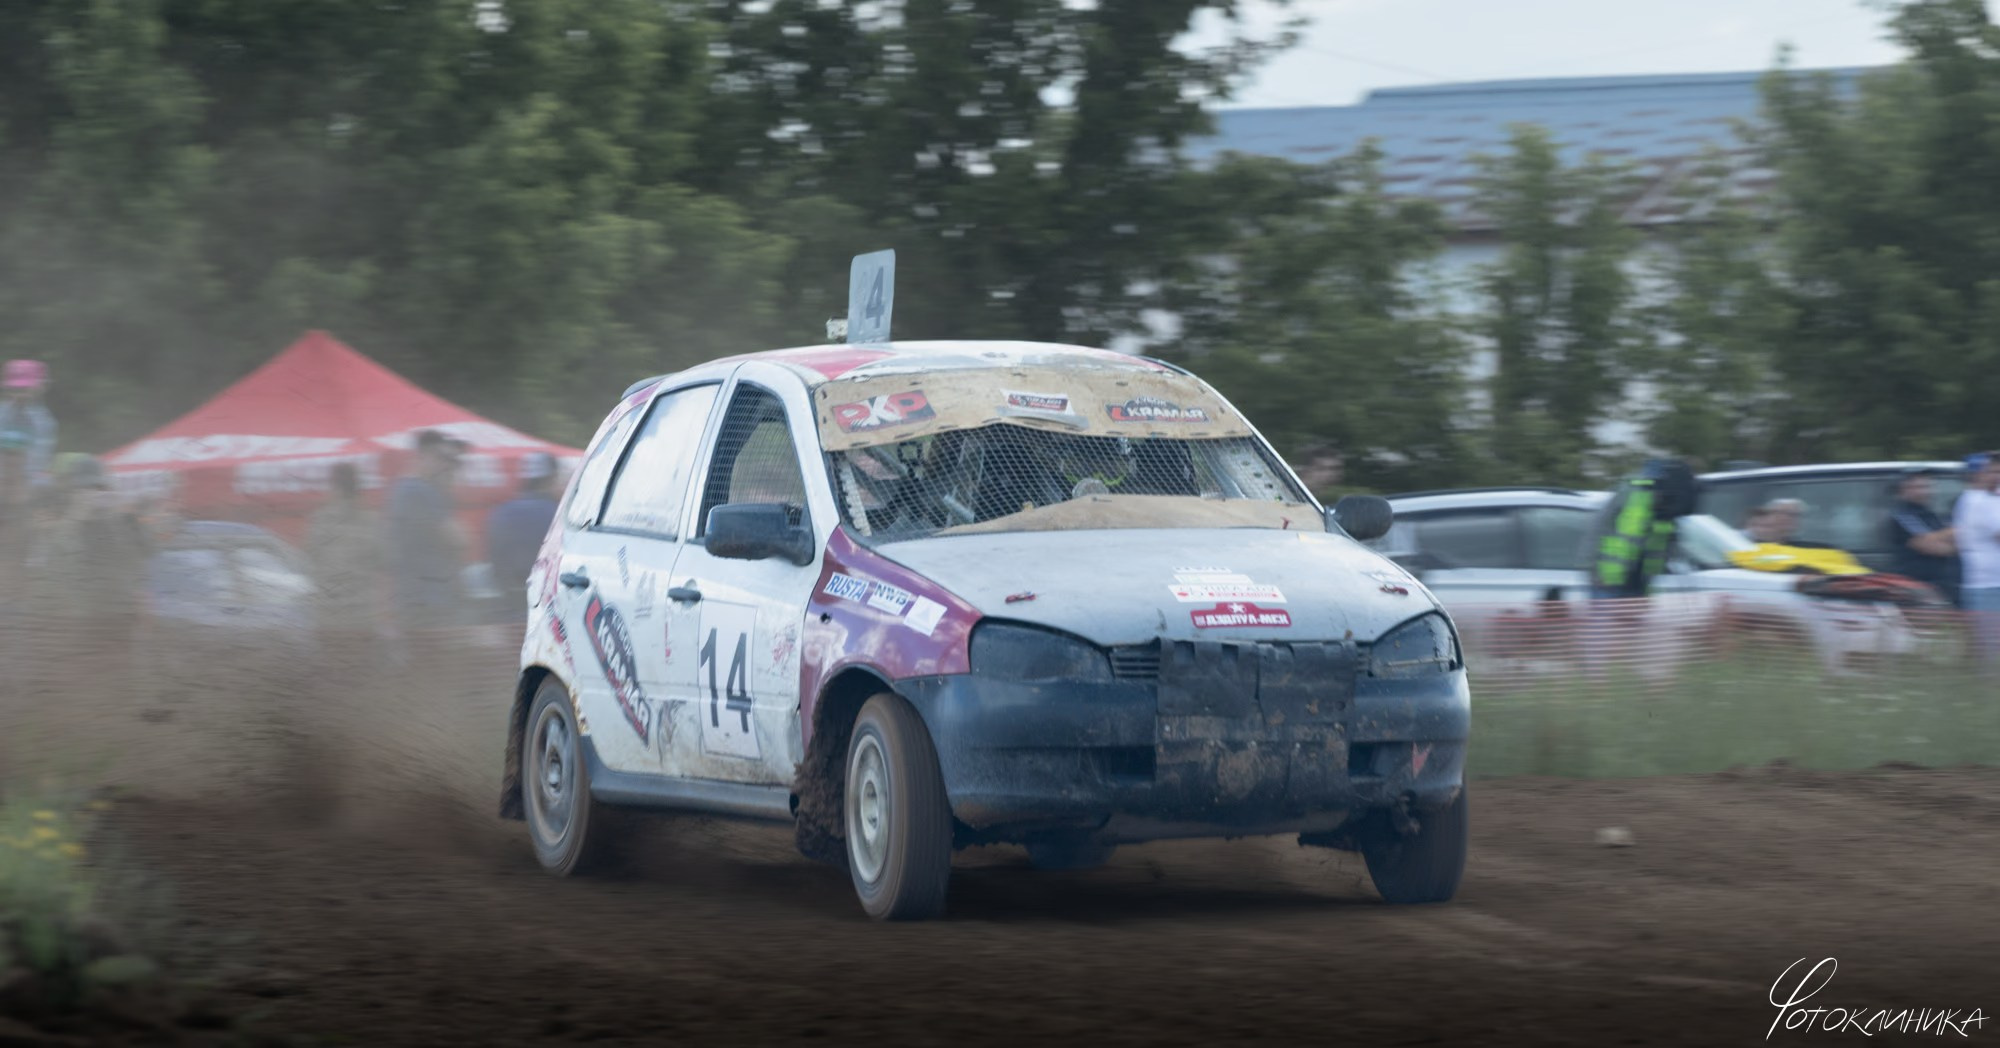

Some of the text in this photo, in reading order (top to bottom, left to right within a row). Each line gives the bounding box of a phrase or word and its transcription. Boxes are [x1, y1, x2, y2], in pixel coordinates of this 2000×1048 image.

[1127, 406, 1205, 419] KRAMAR
[826, 574, 867, 601] RUSTA
[597, 616, 650, 728] KRAMAR
[700, 627, 752, 733] 14
